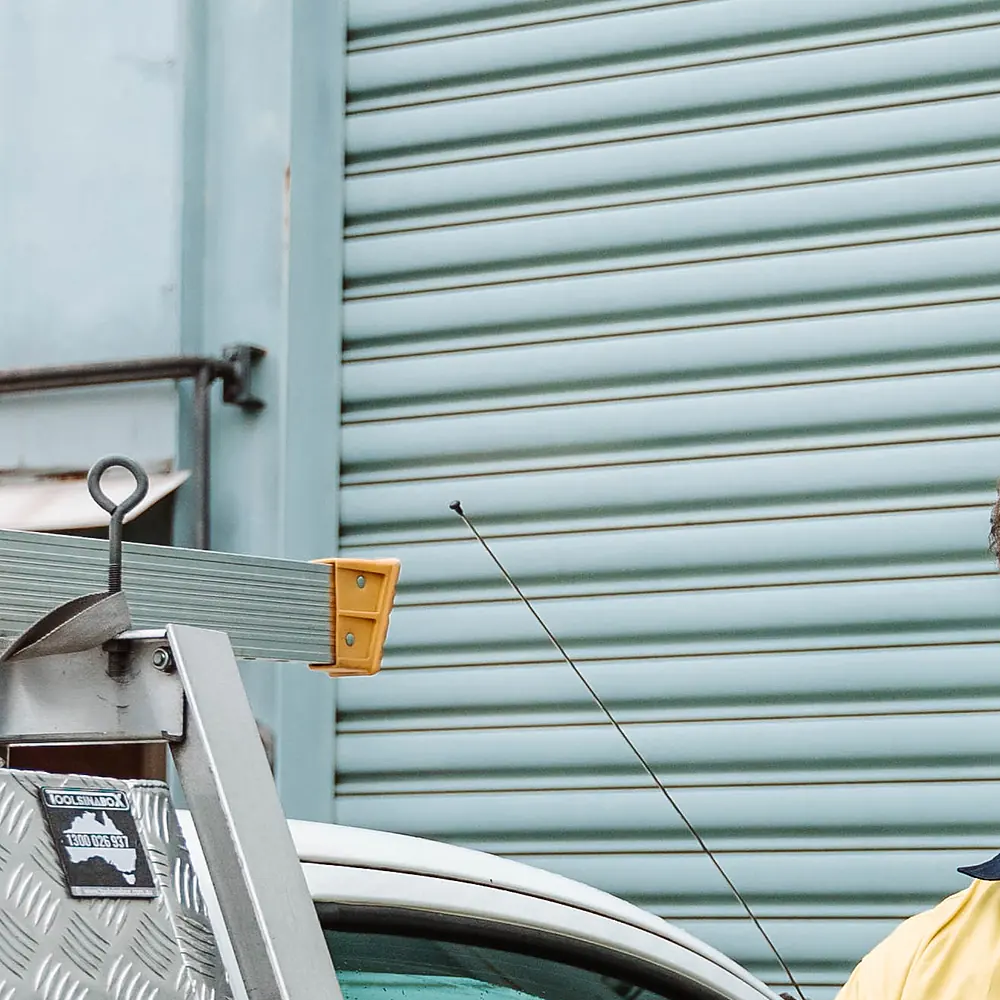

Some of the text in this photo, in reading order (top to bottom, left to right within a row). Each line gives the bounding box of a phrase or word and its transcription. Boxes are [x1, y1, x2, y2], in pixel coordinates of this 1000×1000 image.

[48, 792, 127, 808] TOOLSINABOX
[66, 834, 129, 848] 1300 026 937
